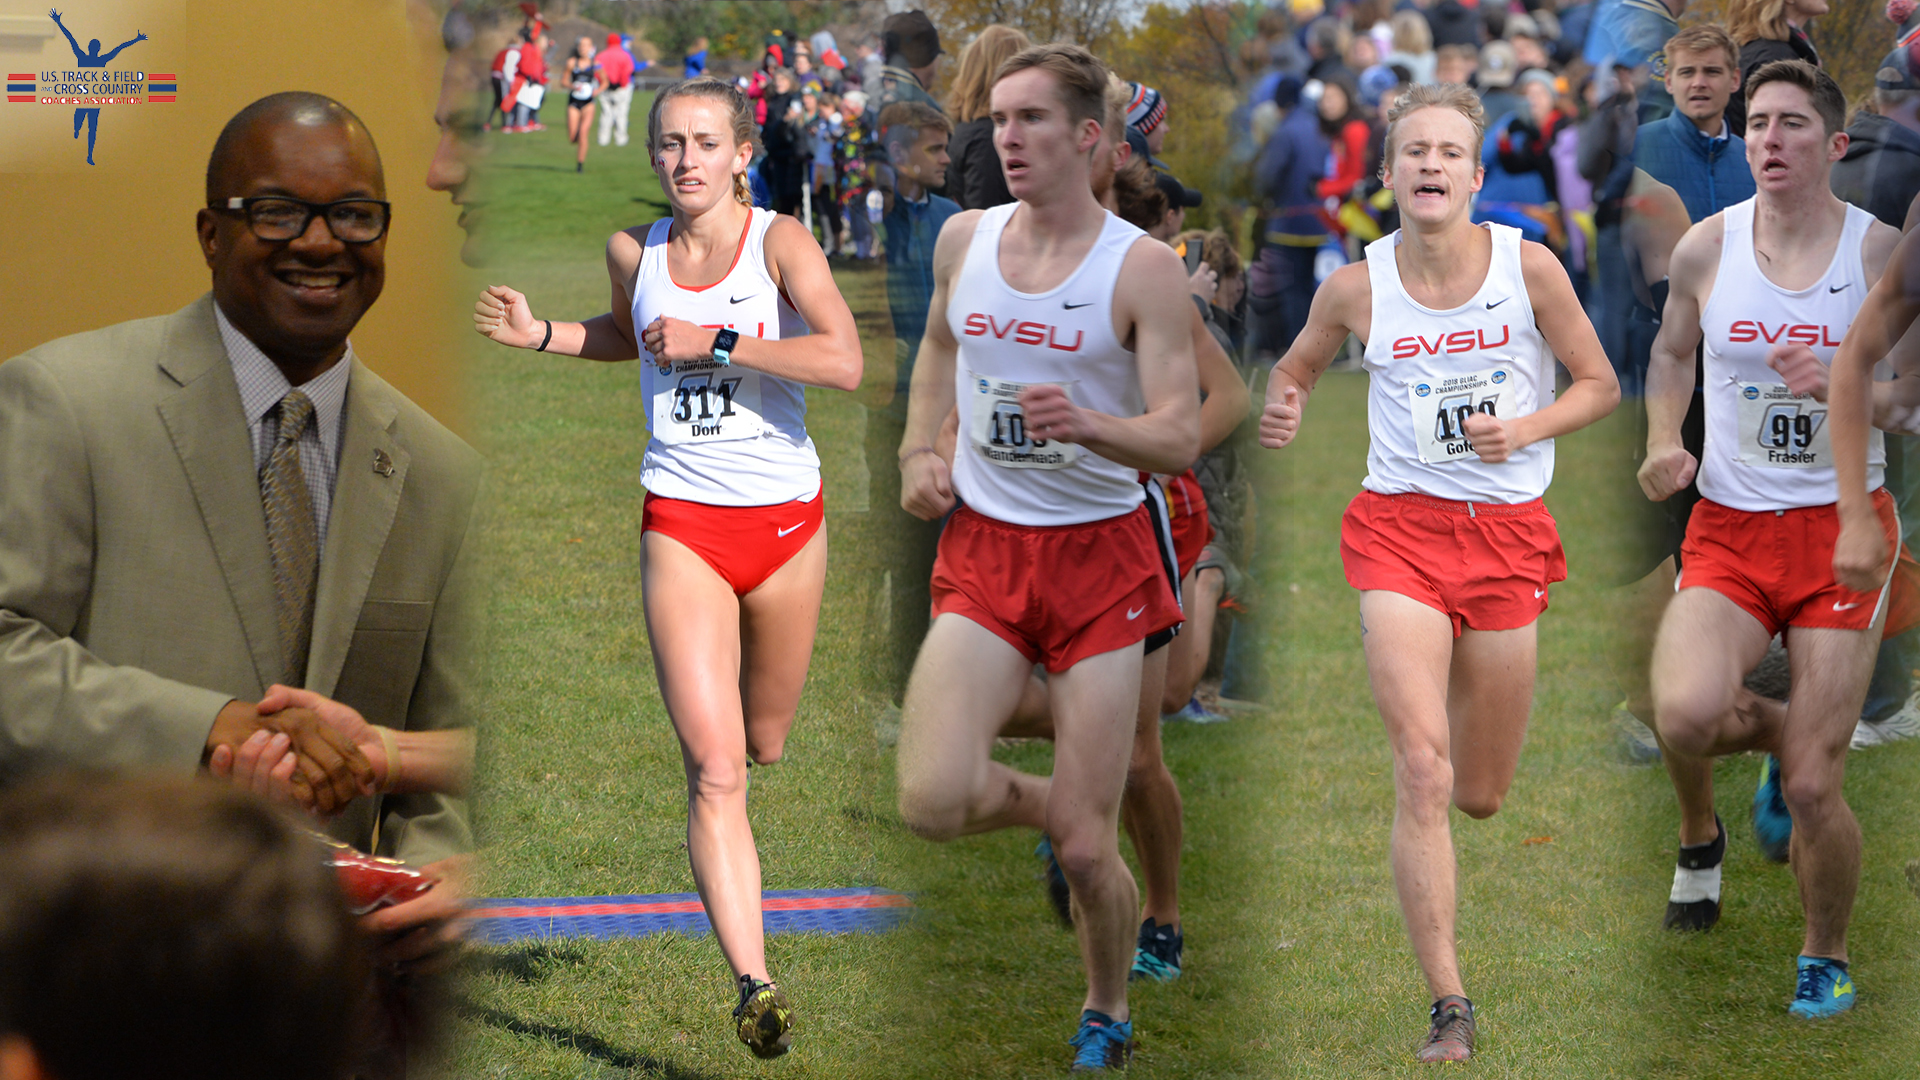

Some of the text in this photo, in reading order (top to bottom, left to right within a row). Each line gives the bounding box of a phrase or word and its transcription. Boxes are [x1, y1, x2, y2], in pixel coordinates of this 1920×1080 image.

[965, 313, 1084, 352] SVSU
[1392, 324, 1510, 360] SVSU
[674, 383, 737, 422] 311
[1435, 380, 1488, 394] CHAMPIONSHIPS
[691, 424, 723, 437] Dorr
[992, 411, 1048, 447] 10
[1772, 414, 1812, 448] 99
[1768, 450, 1817, 463] Frasier
